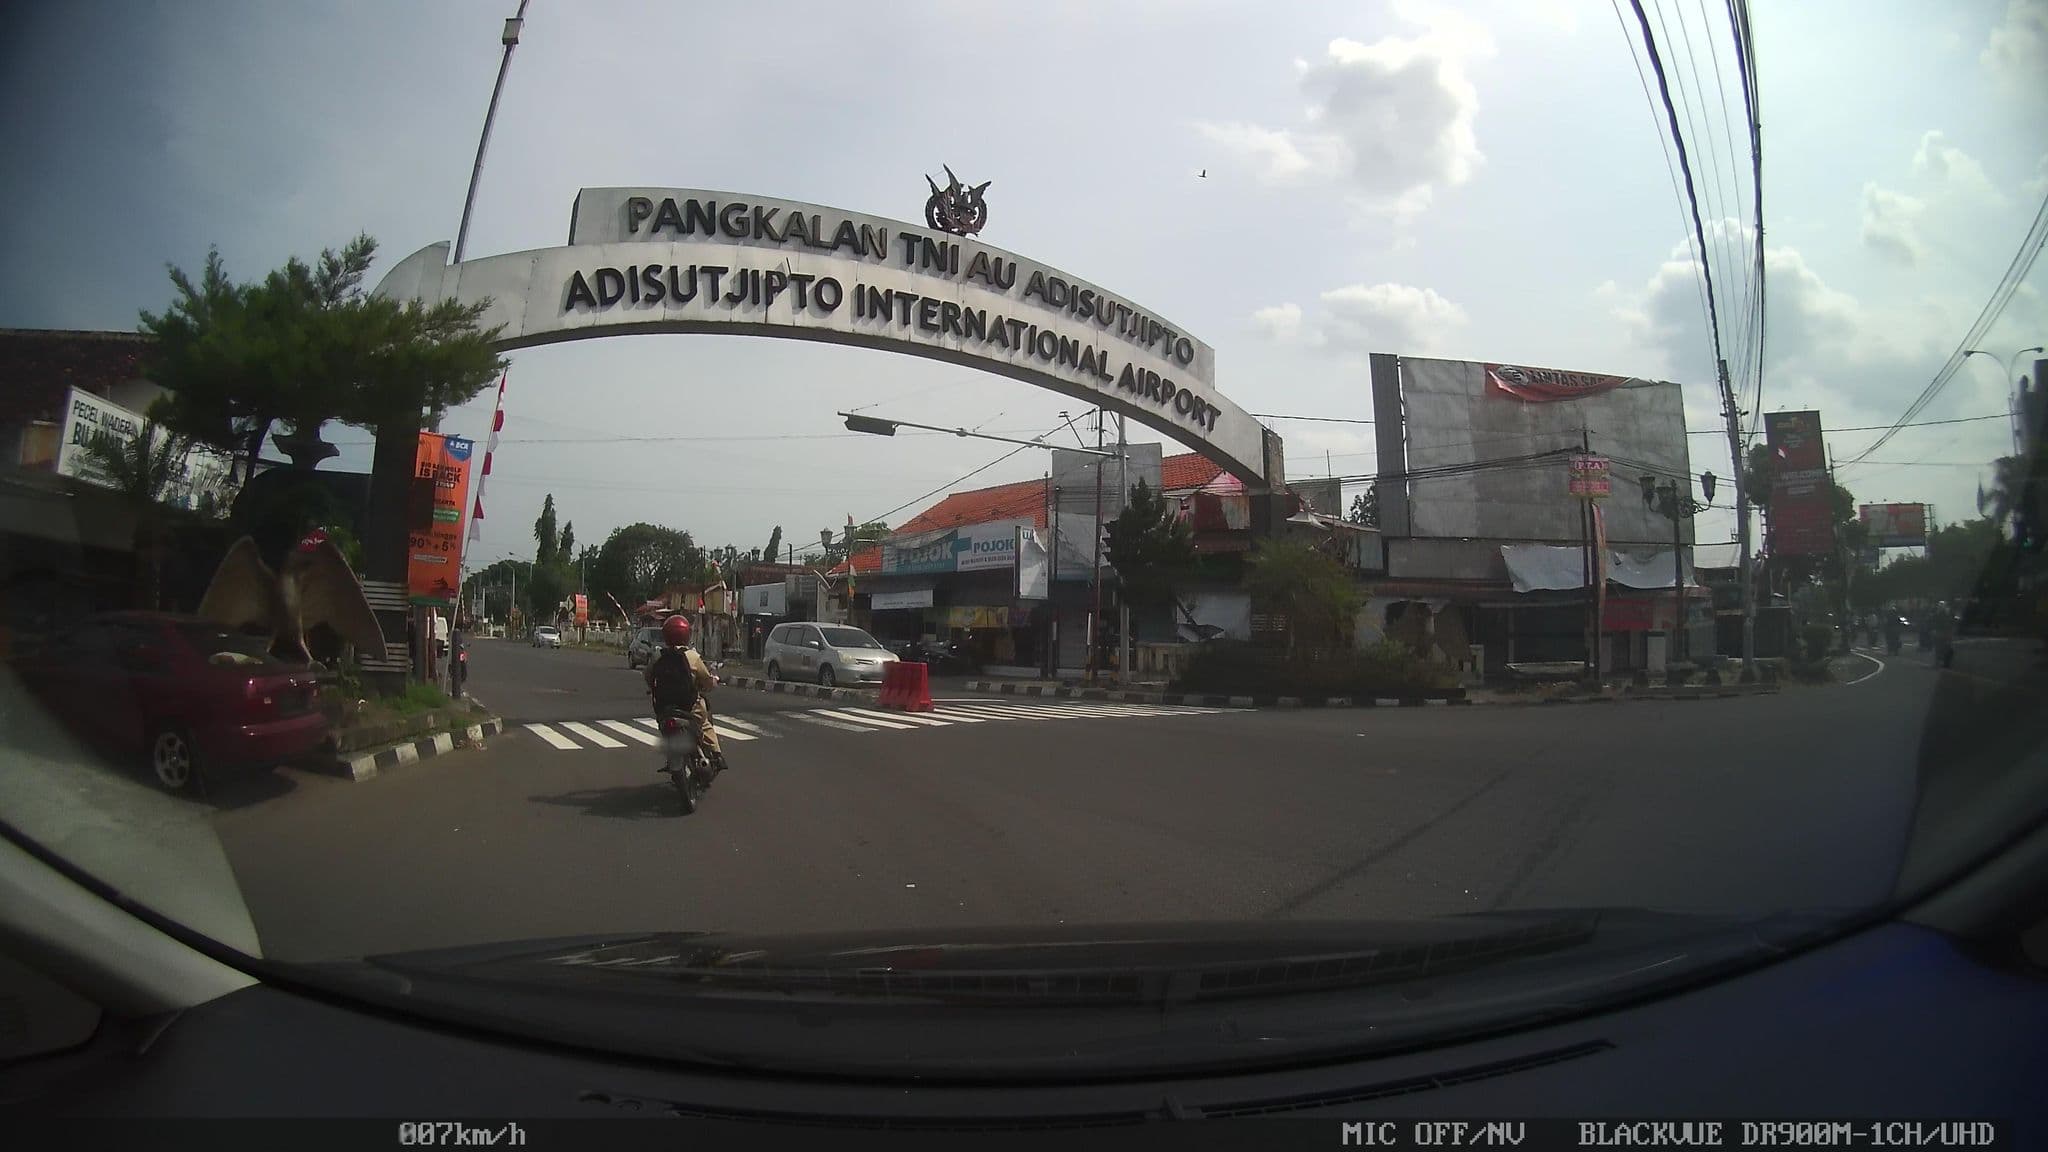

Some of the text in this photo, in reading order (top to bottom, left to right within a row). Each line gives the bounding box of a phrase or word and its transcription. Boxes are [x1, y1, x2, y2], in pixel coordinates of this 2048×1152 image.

[626, 196, 1195, 365] PANGKALAN TNI AU ADISUTJIPTO
[565, 263, 1222, 433] ADISUTJIPTO INTERNATIONAL AIRPORT
[73, 400, 132, 435] PECEL WADER
[74, 423, 90, 447] BU
[419, 467, 431, 477] IS
